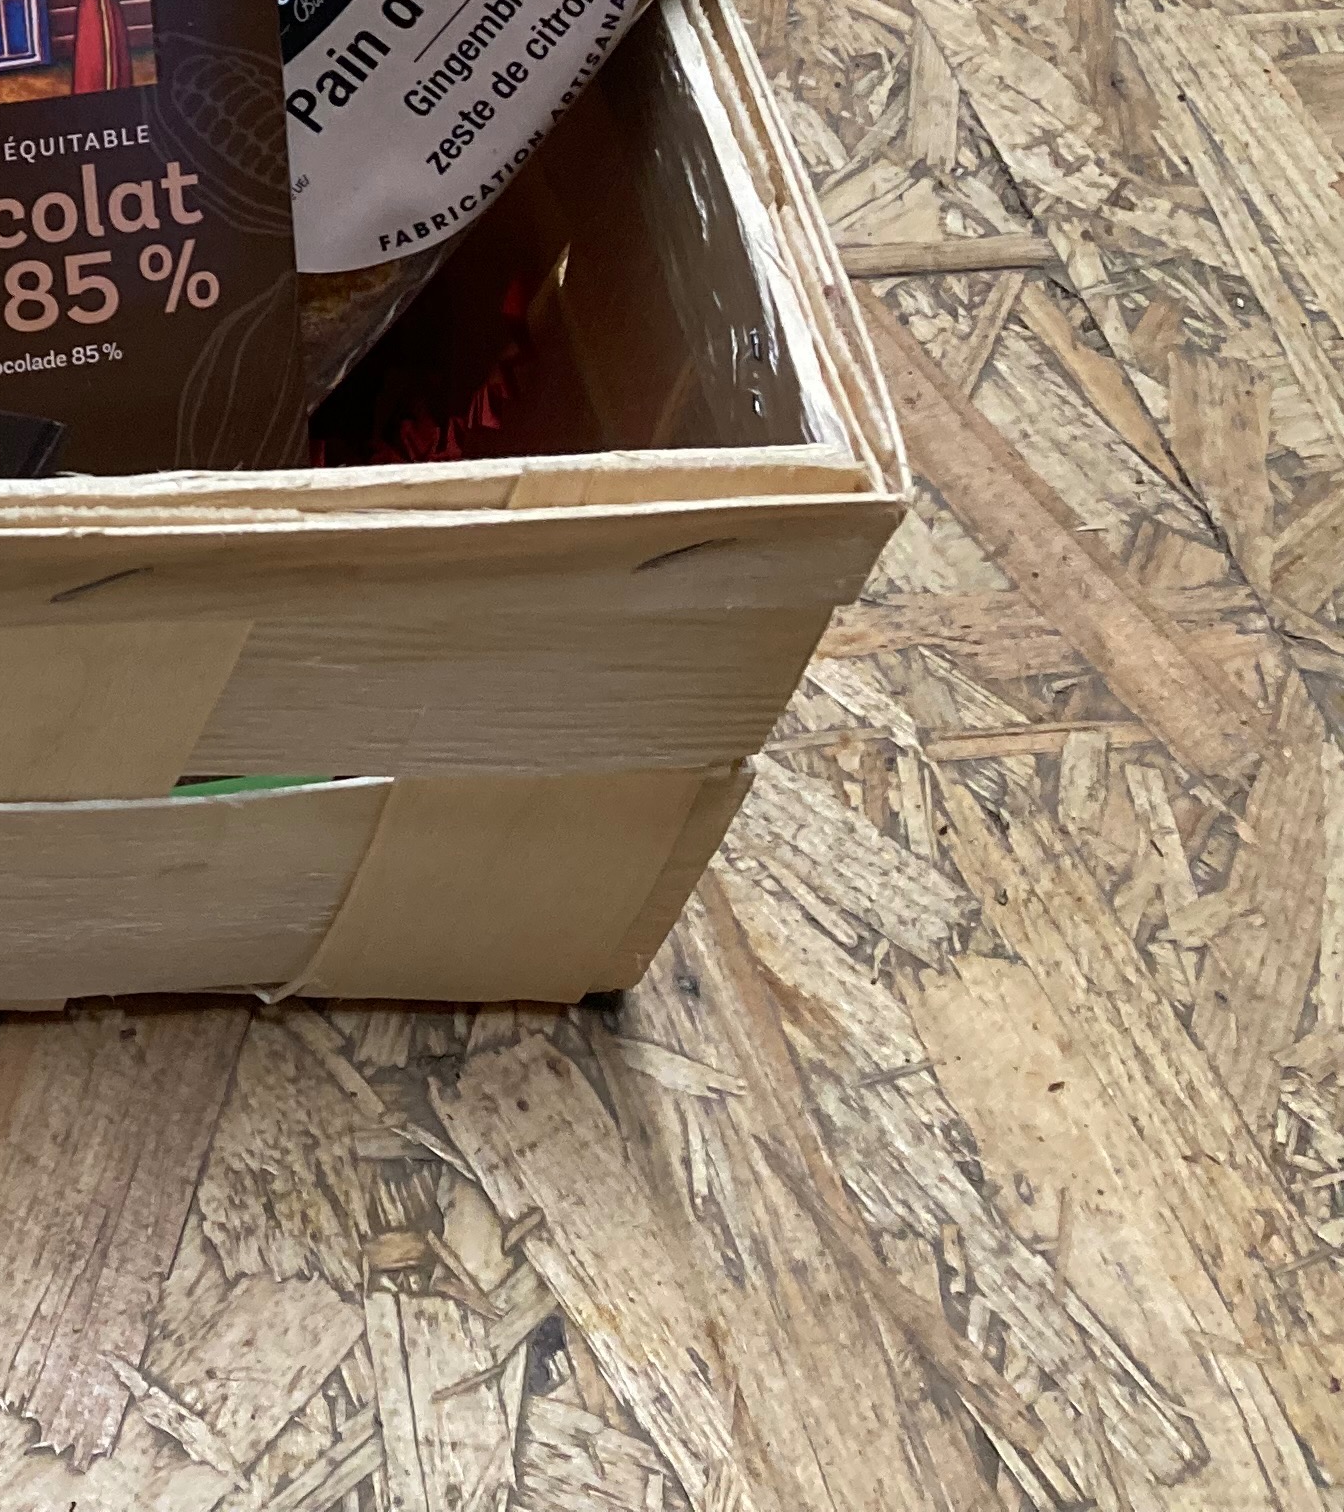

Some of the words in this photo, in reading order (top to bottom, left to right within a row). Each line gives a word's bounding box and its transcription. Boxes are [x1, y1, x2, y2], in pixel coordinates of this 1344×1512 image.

[286, 29, 392, 134] Pain
[426, 100, 495, 176] zeste
[492, 61, 529, 100] de
[3, 124, 151, 163] ÉQUITABLE
[379, 130, 545, 251] FABRICATION
